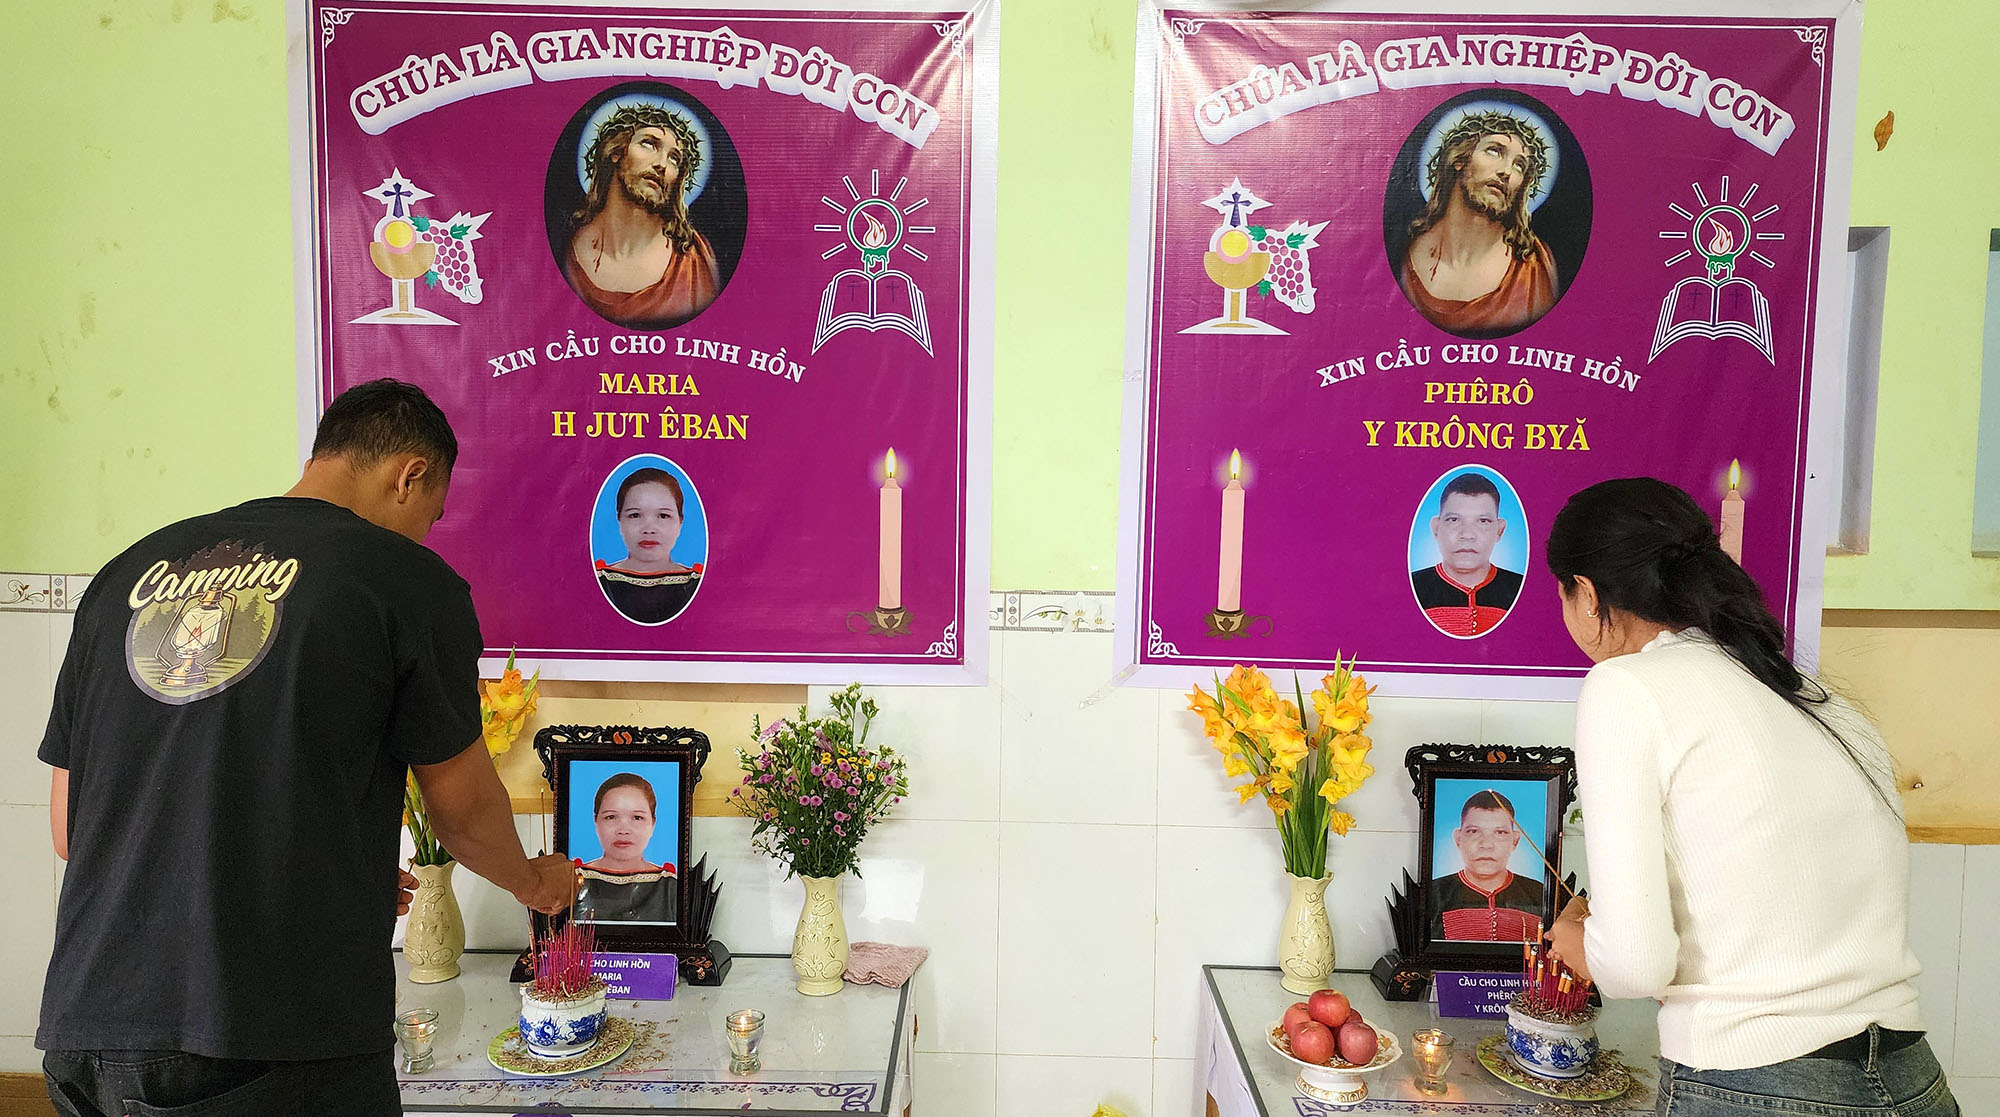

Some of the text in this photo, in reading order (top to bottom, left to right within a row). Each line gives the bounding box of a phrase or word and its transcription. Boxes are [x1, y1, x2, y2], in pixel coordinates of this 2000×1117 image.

[354, 32, 927, 131] CHÚA LÀ GIA NGHIỆP ĐỜI CON
[1199, 38, 1782, 137] CHÚA LÀ GIA NGHIỆP ĐỜI CON
[487, 329, 806, 383] XIN CẦU CHO LINH HỒN
[1315, 338, 1641, 392] XIN CẦU CHO LINH HỒN
[599, 372, 700, 396] MARIA
[1424, 377, 1534, 405] PHÊRÔ
[552, 405, 749, 440] H JUT ÊBAN
[1362, 414, 1590, 450] Y KRÔNG BYĂ
[129, 553, 299, 609] Camping
[609, 959, 629, 969] LINH
[631, 958, 650, 969] HỒN
[1459, 976, 1542, 988] CẦU CHO LINH HN
[1474, 1003, 1507, 1013] Y KRÔN
